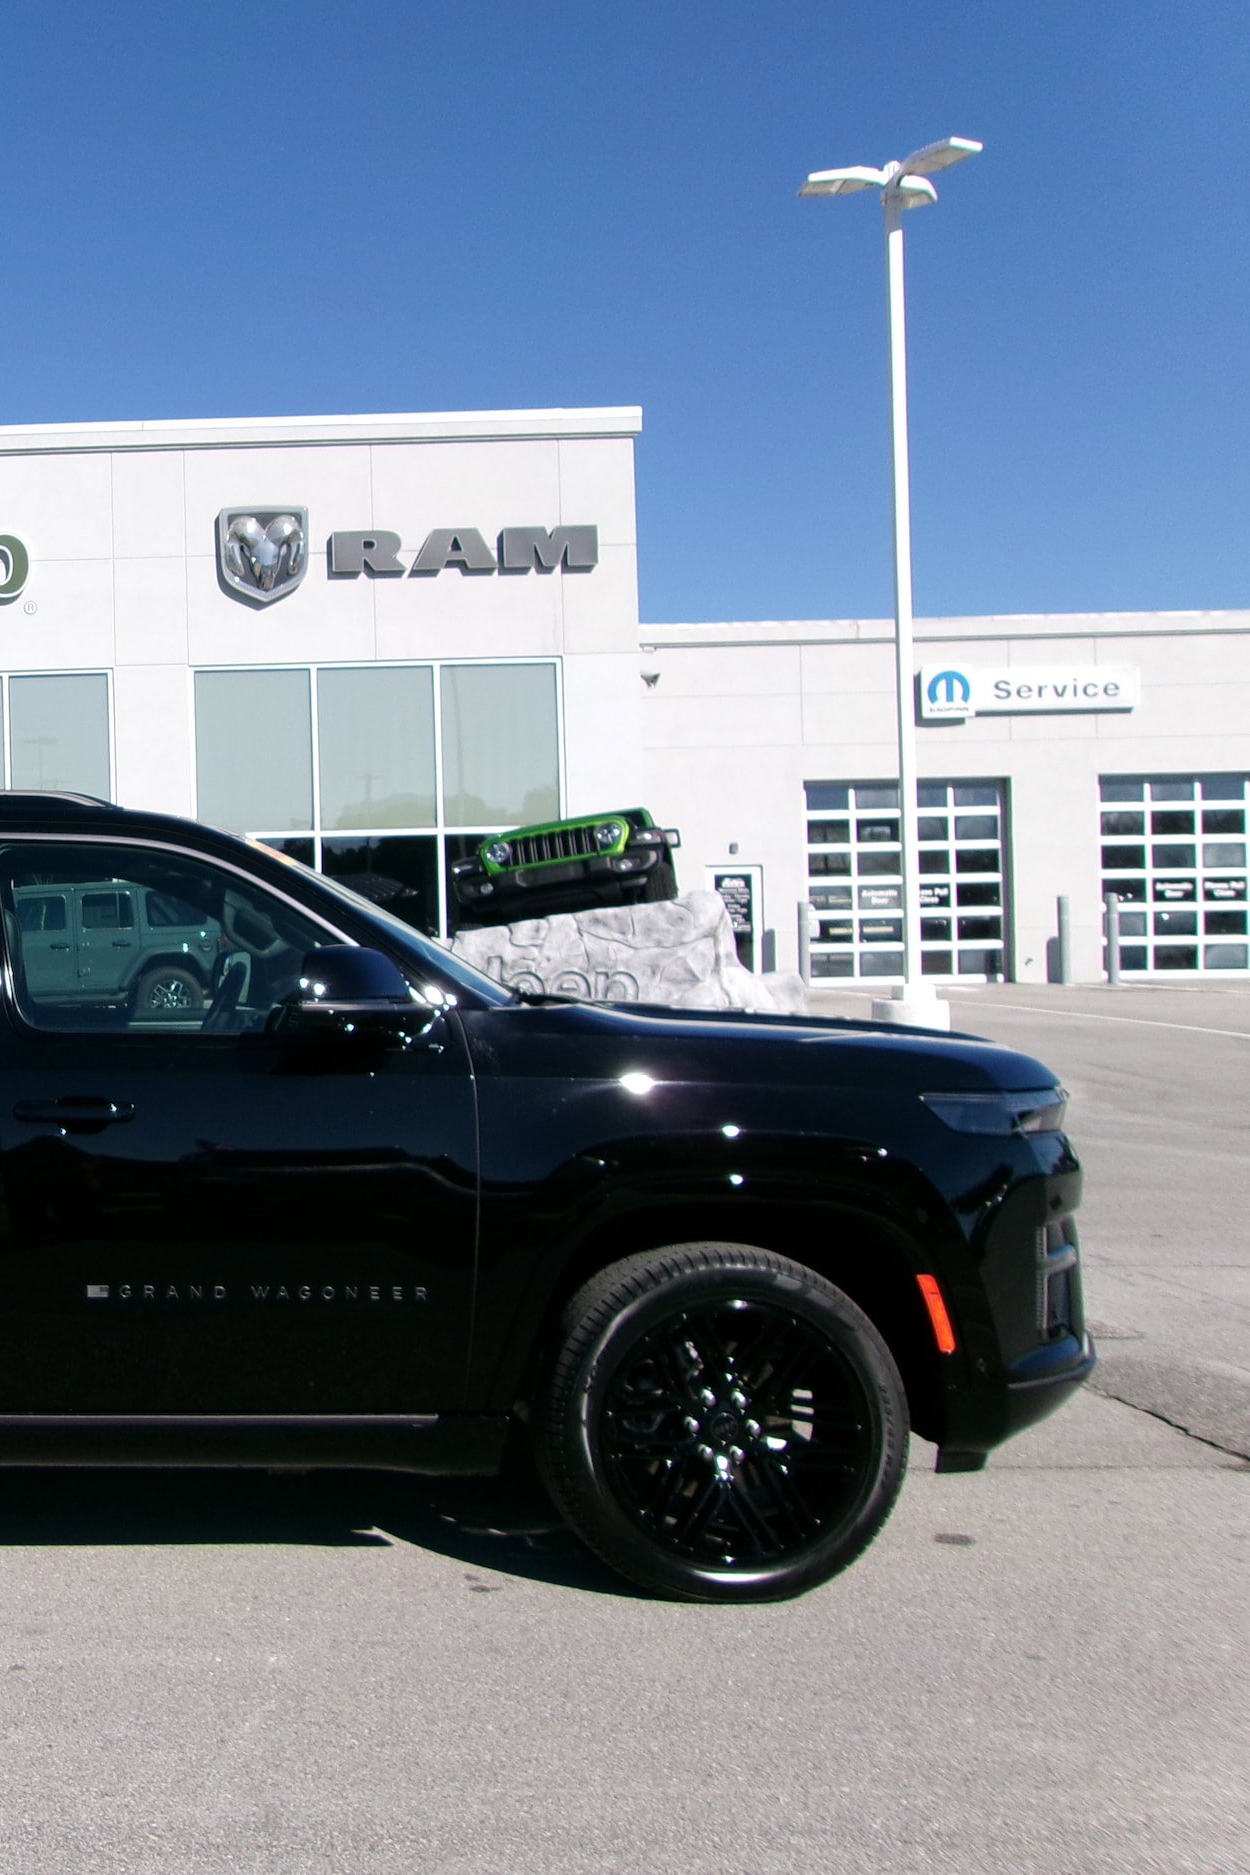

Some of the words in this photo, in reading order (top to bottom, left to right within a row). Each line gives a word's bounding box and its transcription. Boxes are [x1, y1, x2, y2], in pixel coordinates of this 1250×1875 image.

[327, 524, 599, 580] RAM
[993, 677, 1121, 700] Service
[118, 1284, 227, 1300] GRAND
[250, 1284, 429, 1300] WAGONEER
